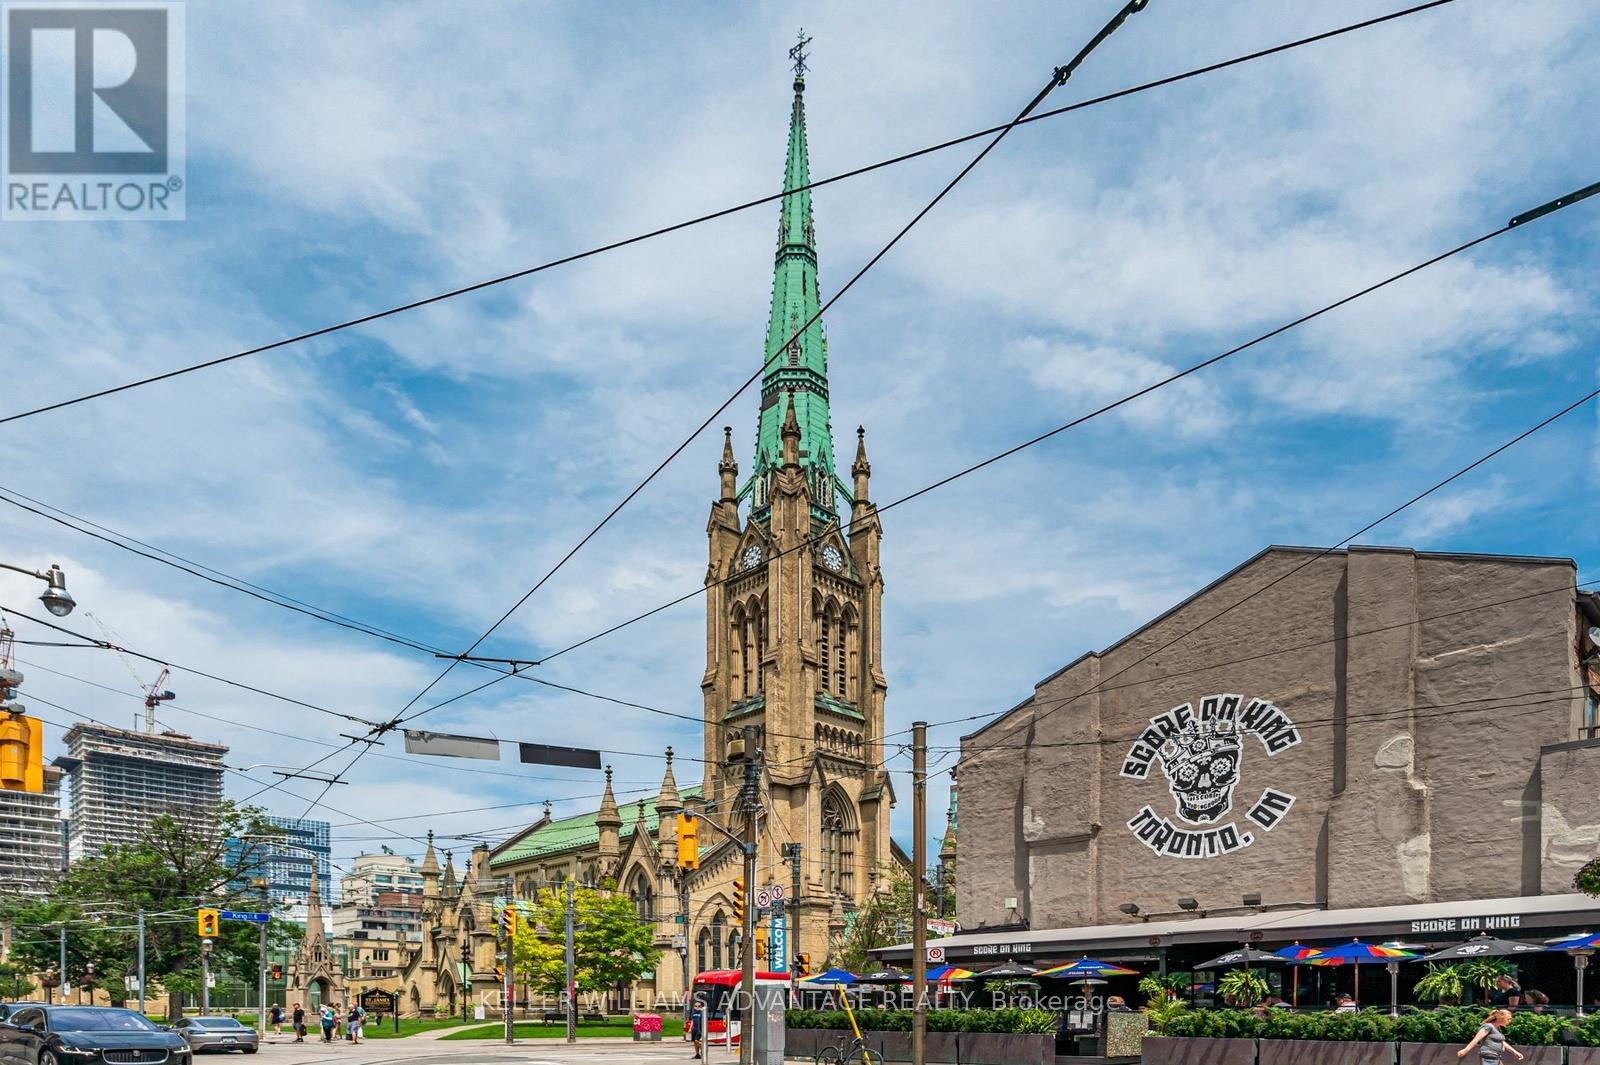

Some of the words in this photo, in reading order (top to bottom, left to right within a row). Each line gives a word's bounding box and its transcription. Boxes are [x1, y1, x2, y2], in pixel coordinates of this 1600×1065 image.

[1120, 702, 1195, 779] SCORE
[1200, 694, 1244, 724] ON
[1240, 697, 1302, 756] KING
[1245, 787, 1296, 832] ON
[775, 918, 784, 969] WELCOM
[1411, 918, 1456, 932] SCORE
[1461, 917, 1480, 929] ON
[1485, 915, 1520, 928] KING
[973, 945, 998, 955] SCORE
[1000, 944, 1010, 953] ON
[1012, 943, 1031, 953] KING
